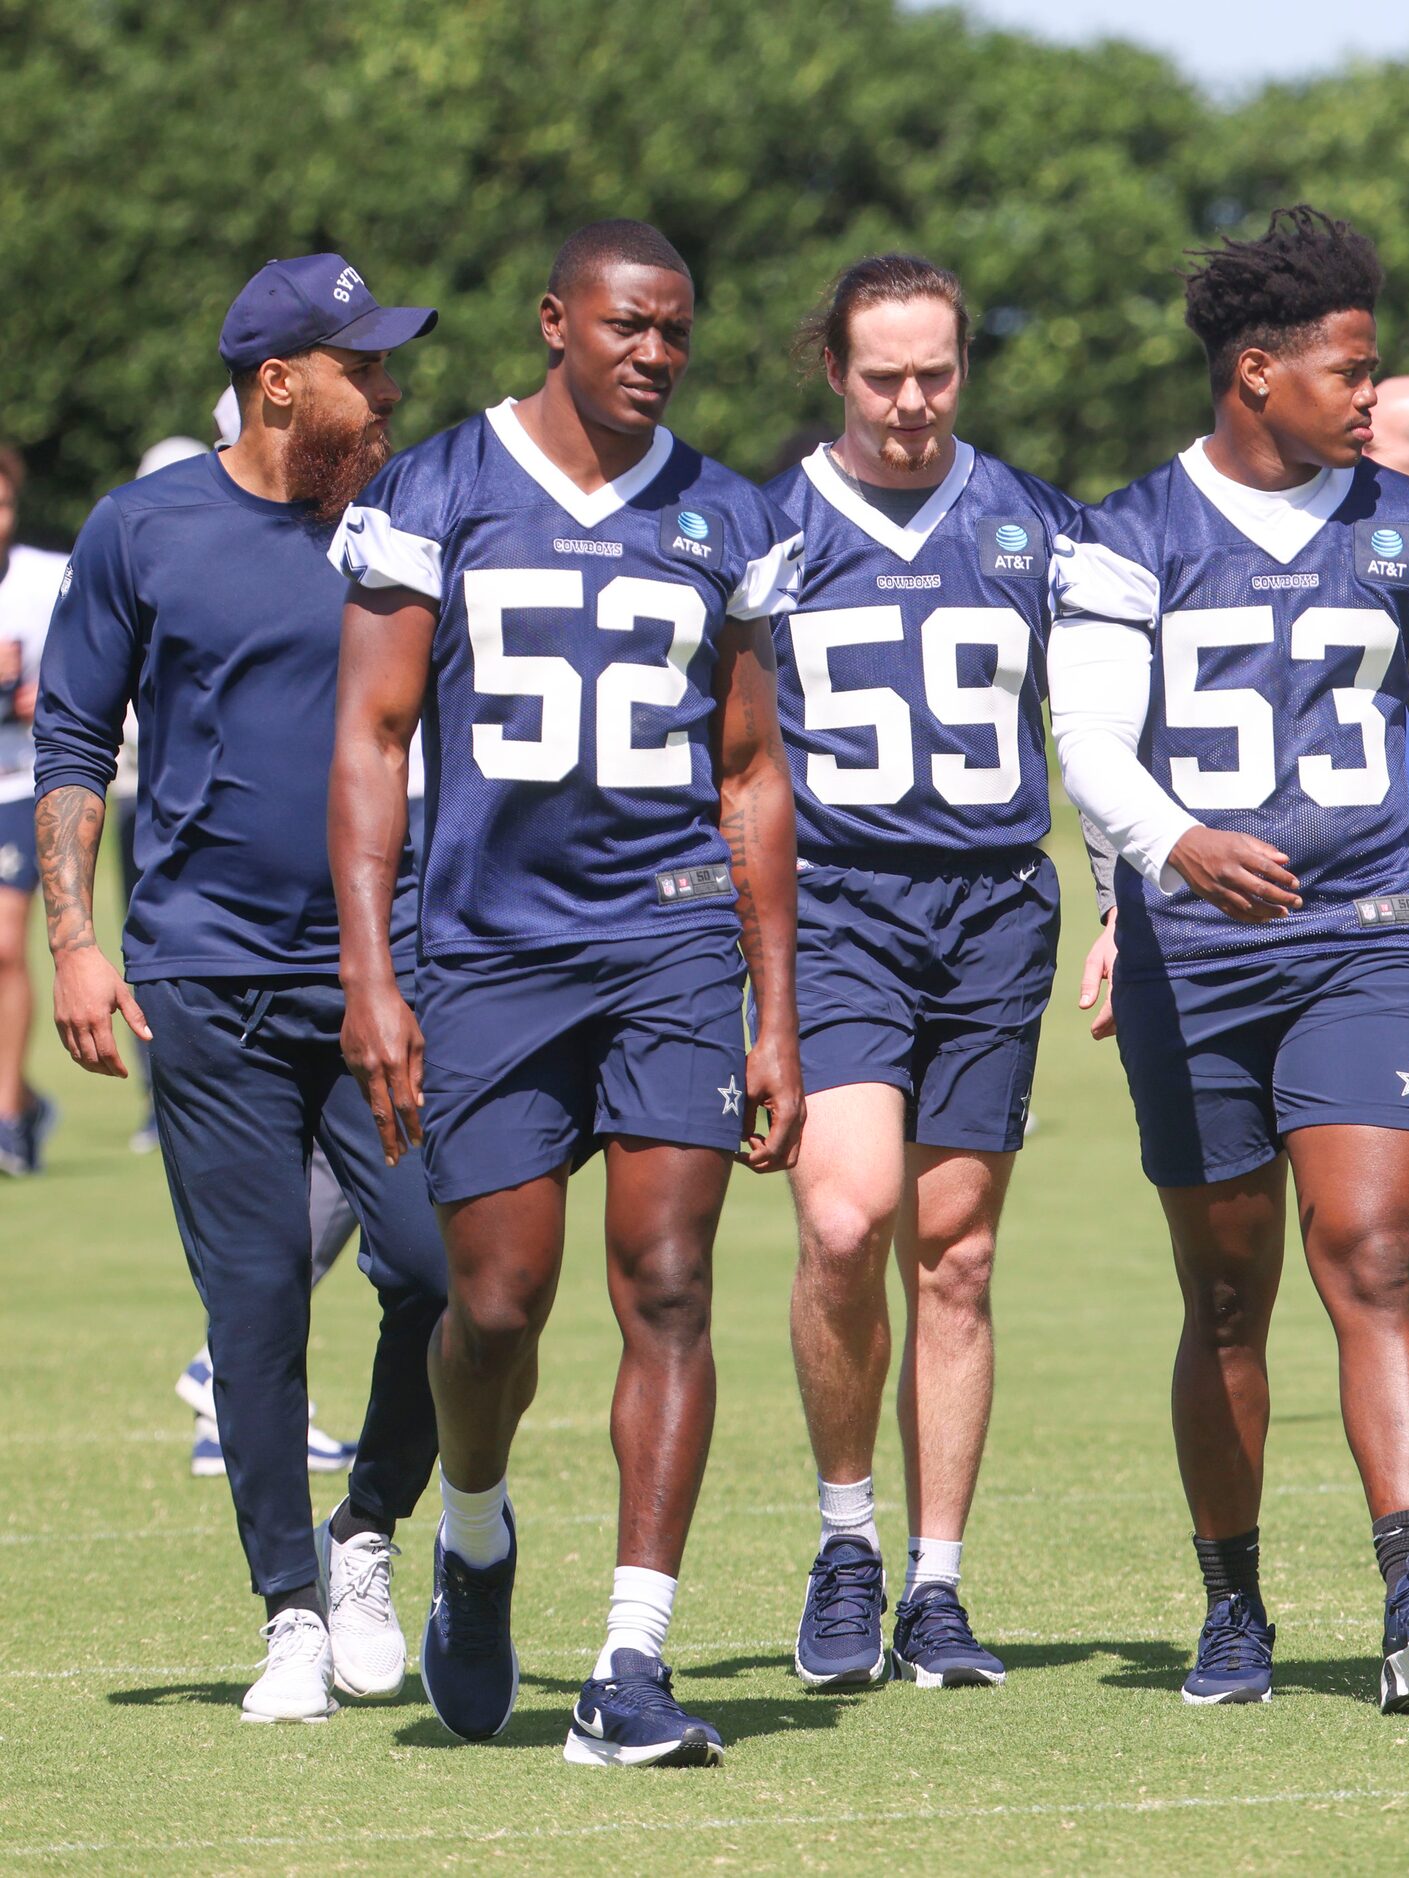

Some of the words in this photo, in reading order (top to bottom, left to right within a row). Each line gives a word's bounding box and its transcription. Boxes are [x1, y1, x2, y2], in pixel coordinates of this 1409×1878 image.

[333, 266, 365, 303] LAS
[553, 538, 623, 558] COWBOYS
[672, 536, 712, 558] AT&T
[994, 555, 1034, 570] AT&T
[1367, 560, 1408, 577] AT&T
[876, 575, 941, 589] COWBOYS
[1251, 574, 1320, 590] COWBOYS
[463, 567, 709, 789] 52
[788, 604, 1032, 806] 59
[1161, 604, 1400, 811] 53
[696, 870, 710, 882] 50
